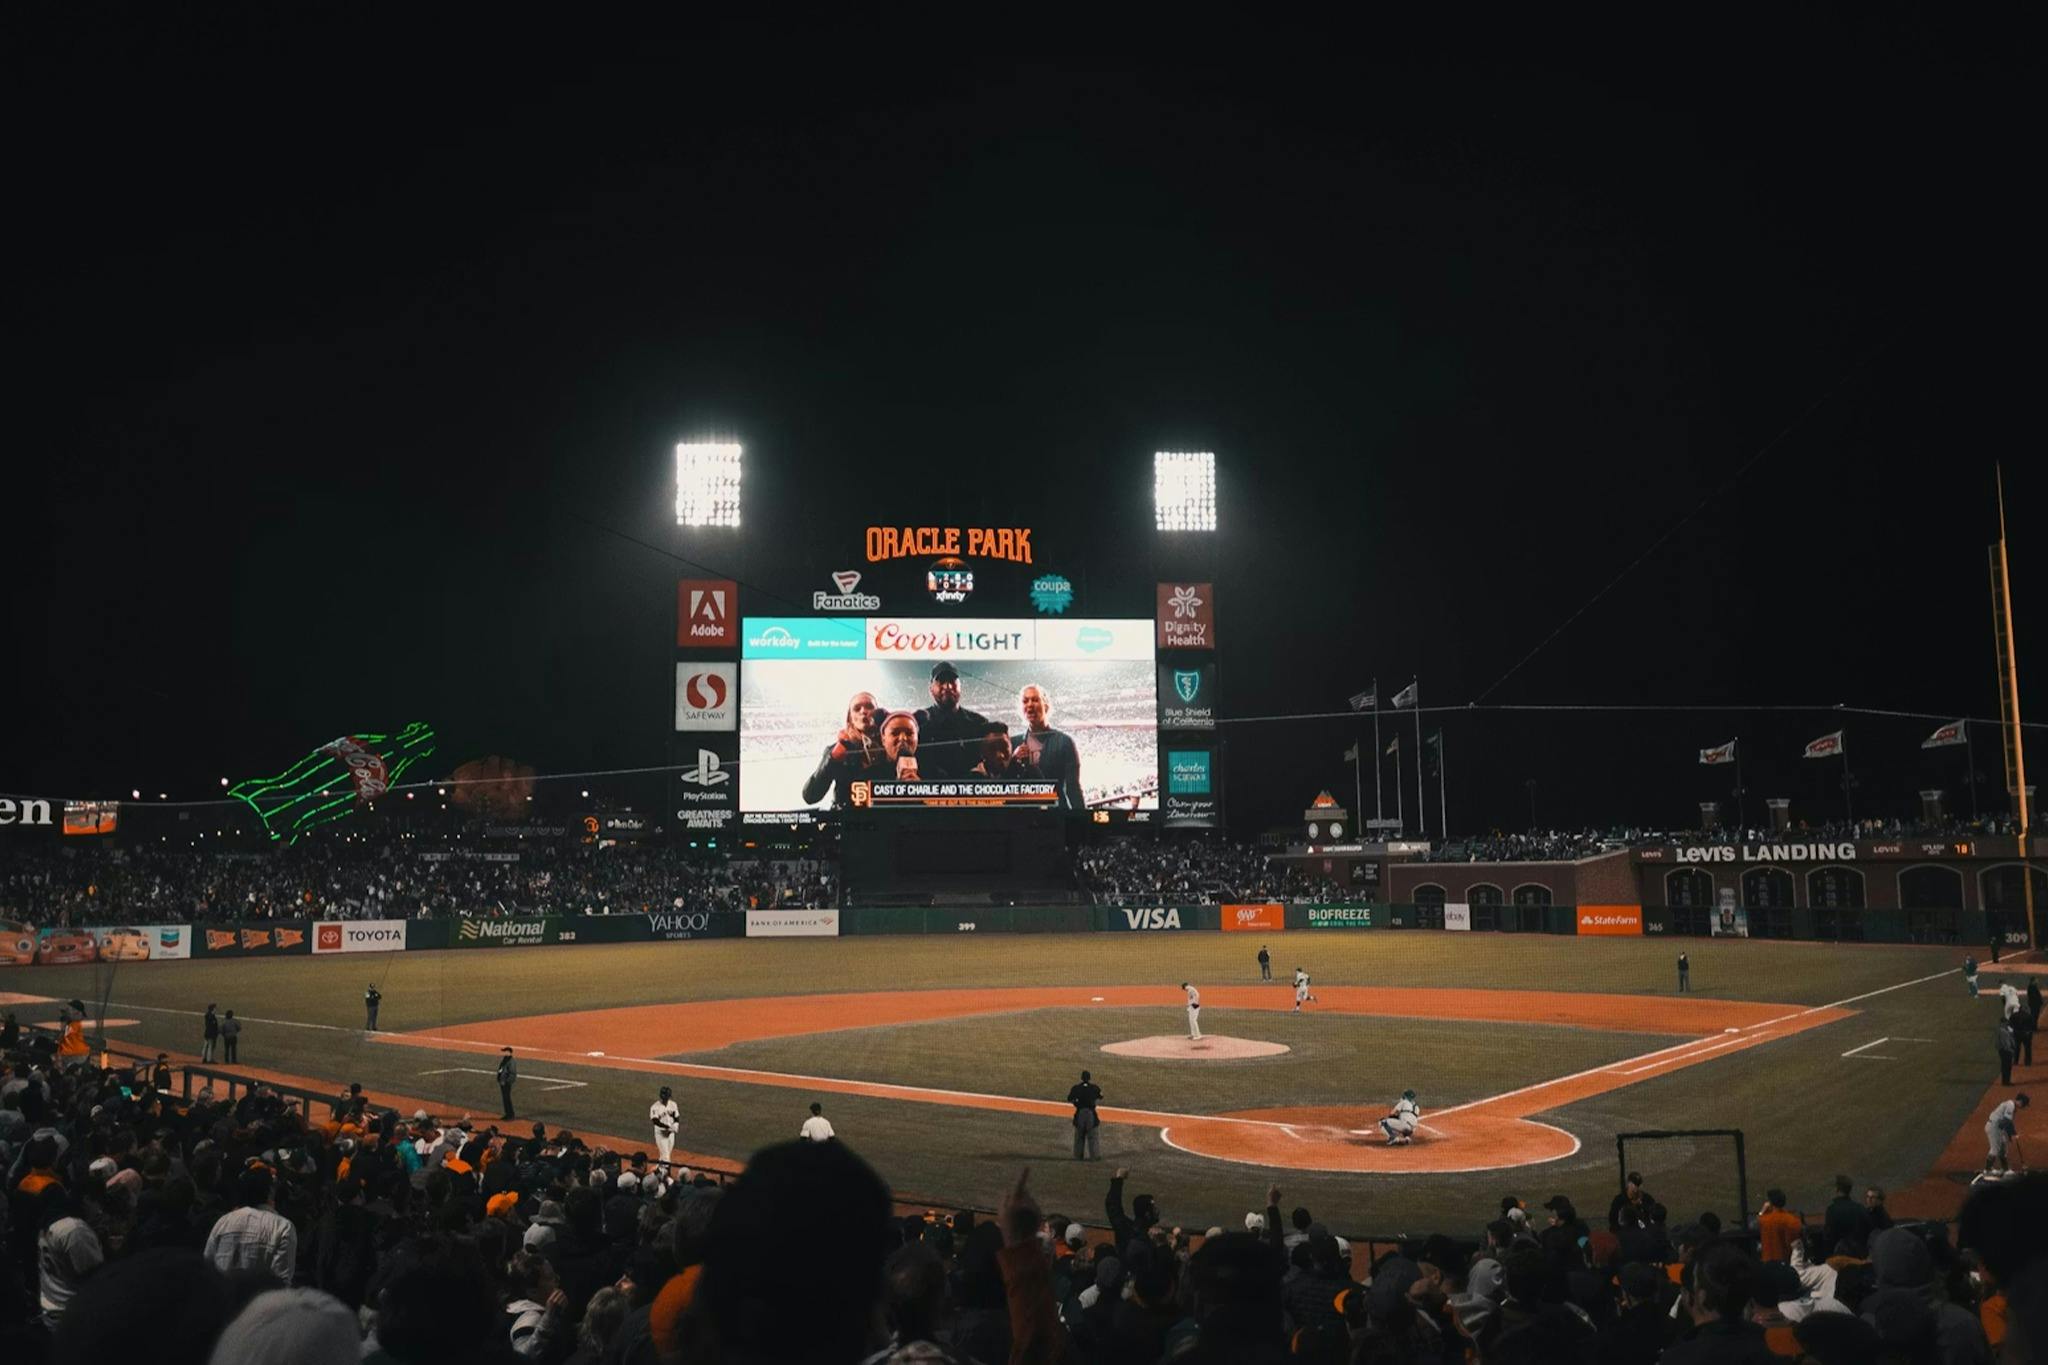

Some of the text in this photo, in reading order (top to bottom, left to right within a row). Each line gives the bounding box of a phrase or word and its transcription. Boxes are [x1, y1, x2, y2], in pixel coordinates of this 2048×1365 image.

[866, 527, 1033, 564] ORACLE PARK
[1034, 580, 1071, 594] coupa
[813, 592, 881, 611] Fanatics
[936, 590, 967, 603] xfinity
[691, 625, 724, 637] Adobe
[1165, 621, 1206, 637] Dignity
[749, 635, 800, 650] workday
[874, 622, 1022, 652] Coors LIGHT
[1167, 635, 1205, 646] Health
[685, 712, 727, 720] SAFEWAY
[1165, 707, 1211, 717] Blue Shield
[1163, 717, 1214, 726] of California
[874, 783, 1055, 796] CAST OF CHARLIE AND THE CHOCOLATE FACTORY
[677, 810, 732, 820] GREATNESS
[1743, 842, 1856, 862] LANDING
[1954, 844, 1968, 854] 18
[648, 913, 710, 932] YAHOO!
[1121, 908, 1181, 930] VISA
[1445, 911, 1466, 922] ebay
[480, 921, 545, 937] National
[958, 922, 976, 931] 399
[1648, 923, 1663, 932] 365
[348, 930, 401, 941] TOYOTA
[502, 936, 543, 945] Car Rental
[2005, 933, 2028, 944] 309
